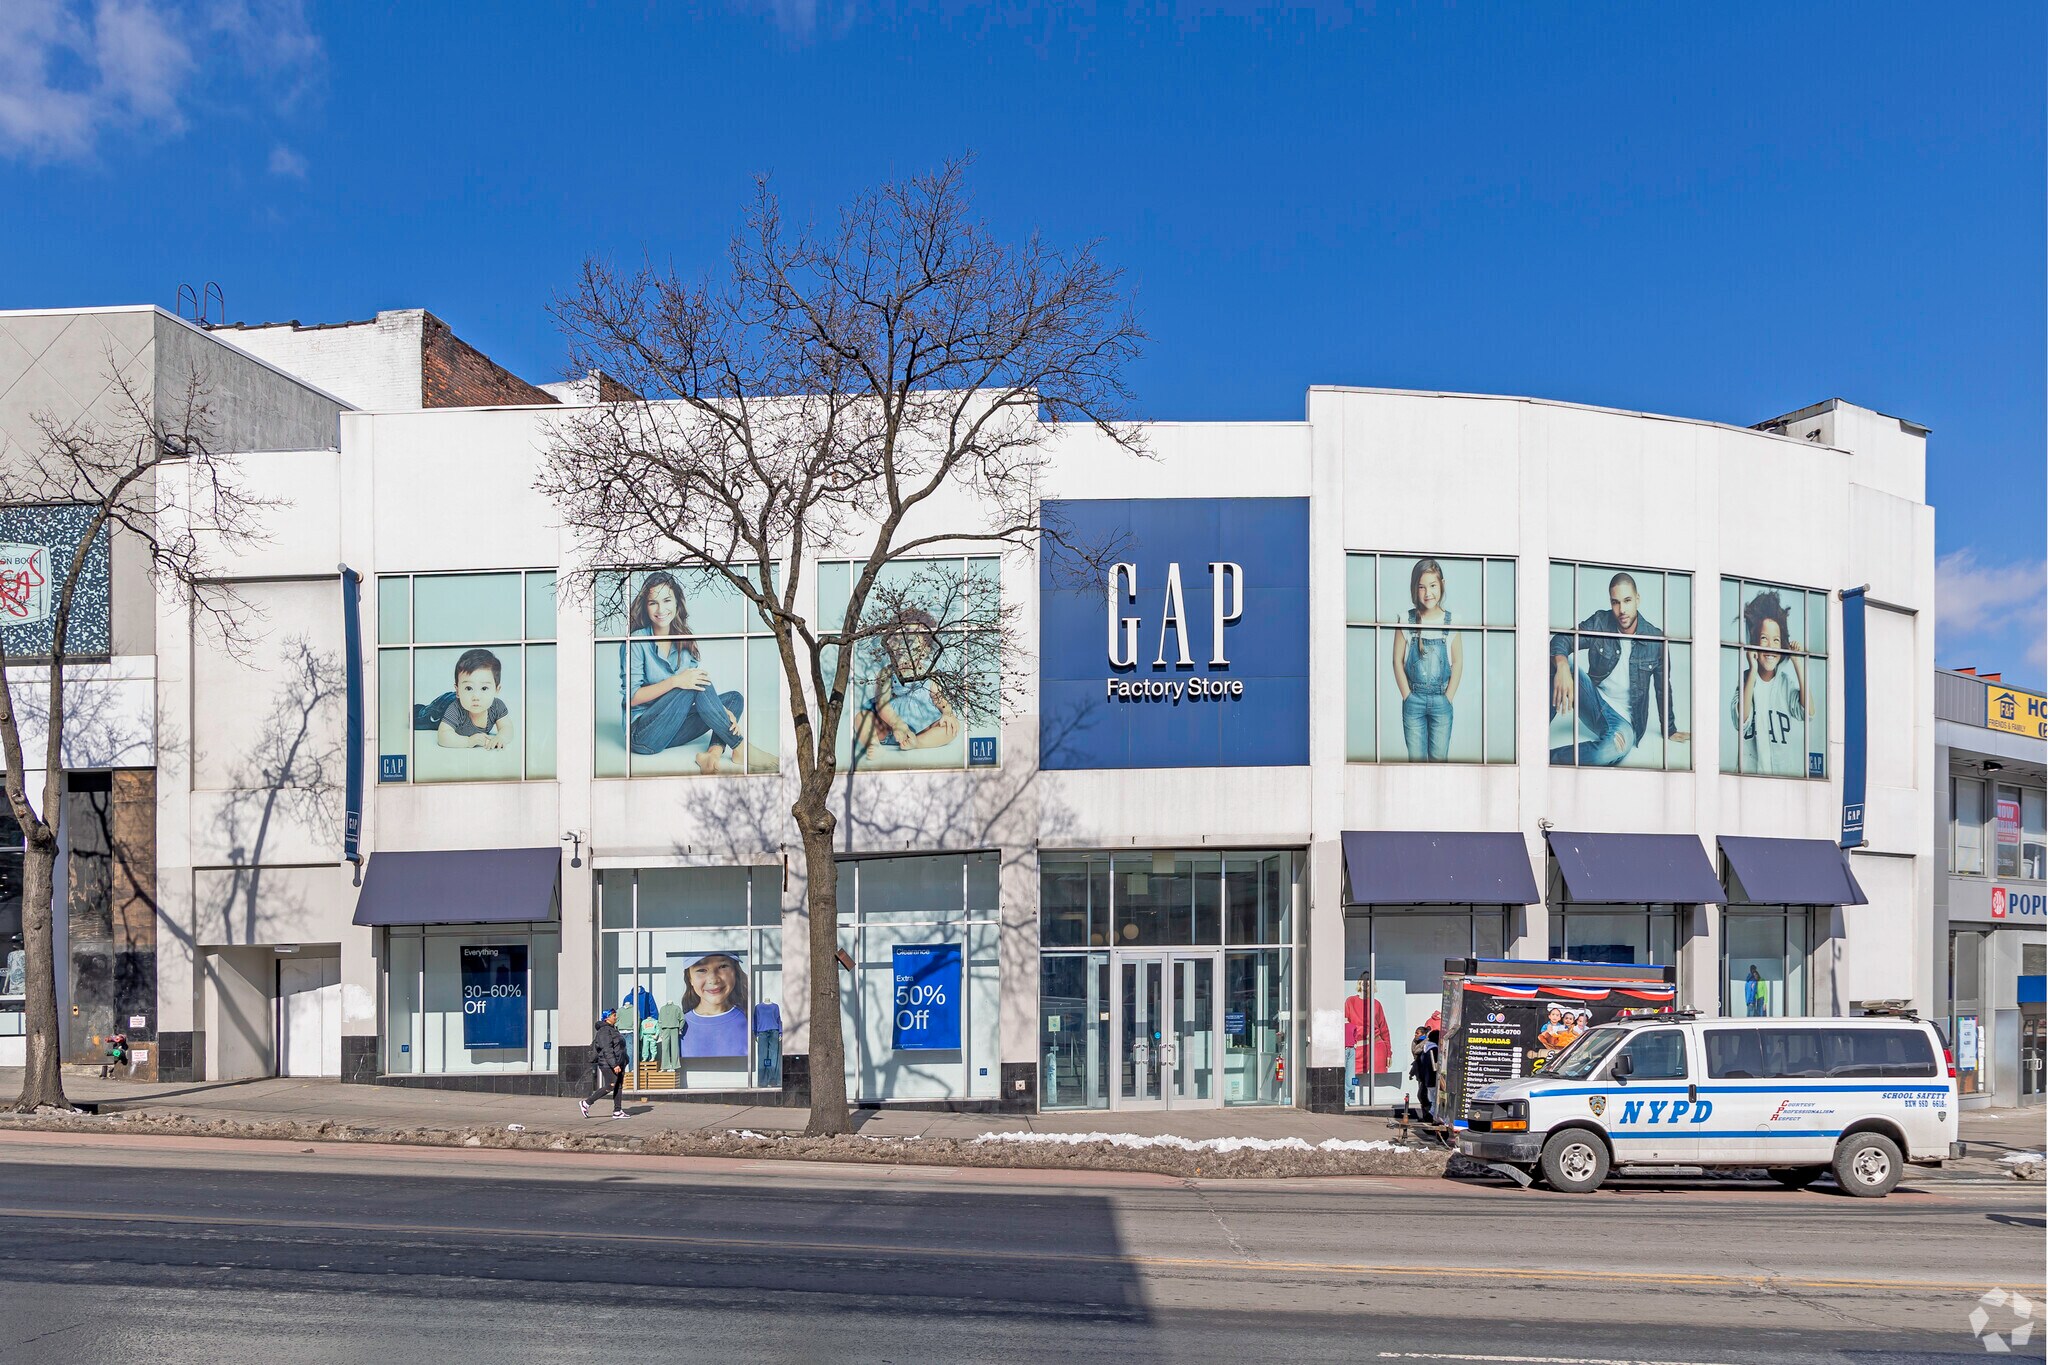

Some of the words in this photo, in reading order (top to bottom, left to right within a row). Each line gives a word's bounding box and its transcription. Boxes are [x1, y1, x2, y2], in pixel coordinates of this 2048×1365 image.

[1108, 562, 1243, 666] GAP
[1107, 678, 1185, 700] Factory
[1188, 677, 1244, 696] Store
[1989, 719, 2007, 729] FRIENDS
[973, 741, 993, 757] GAP
[384, 759, 403, 774] GAP
[1809, 756, 1822, 770] GAP
[1848, 809, 1860, 820] GAP
[464, 949, 499, 957] Everything
[896, 948, 930, 956] Clearance
[896, 984, 946, 1006] 50%
[464, 1000, 486, 1014] Off
[896, 1009, 930, 1031] Off
[1619, 1101, 1713, 1124] NYPD
[1770, 1113, 1802, 1121] RESPECT
[1776, 1106, 1835, 1114] PROFESSIONALISM
